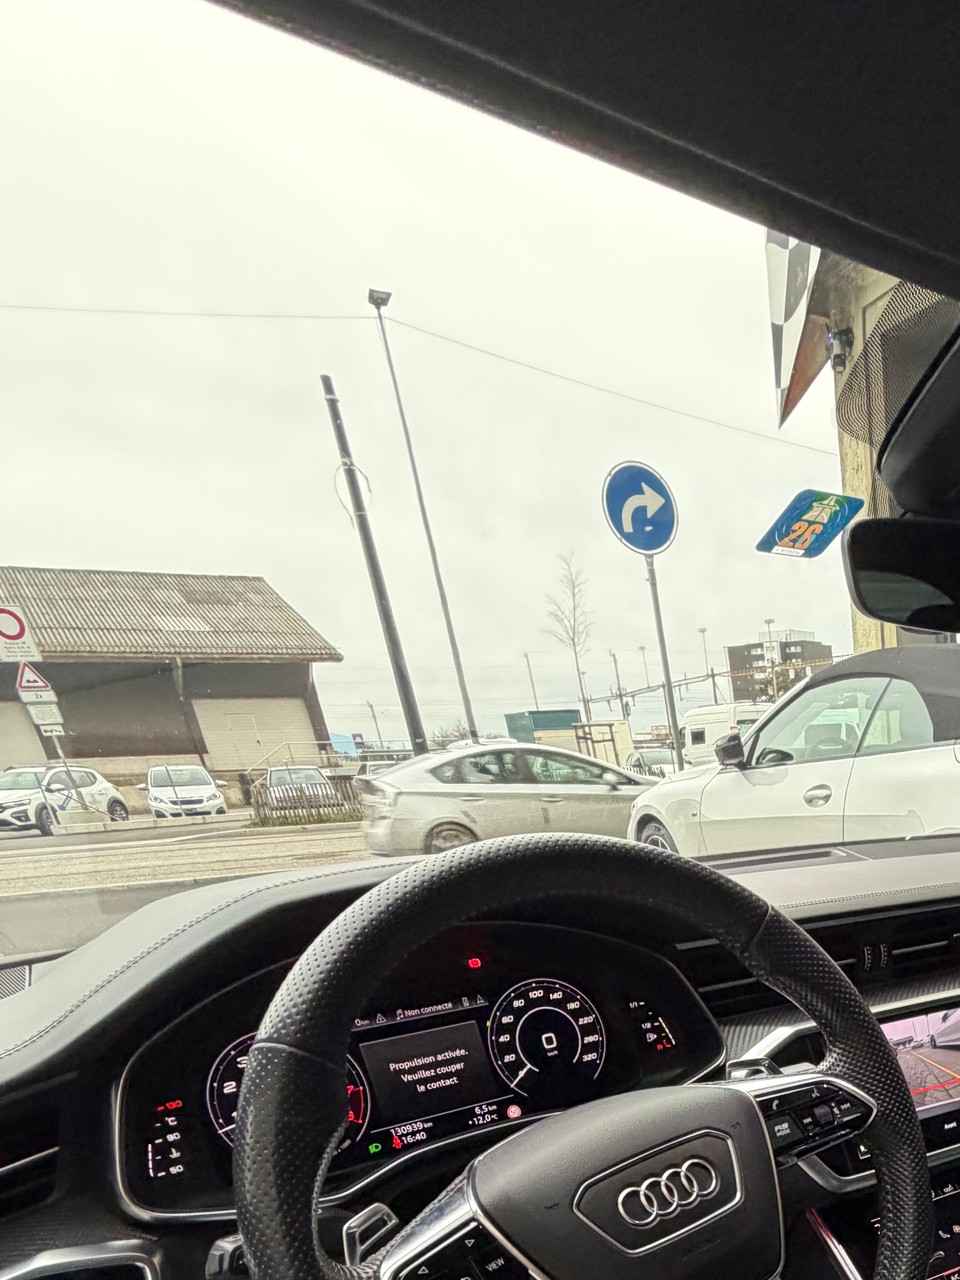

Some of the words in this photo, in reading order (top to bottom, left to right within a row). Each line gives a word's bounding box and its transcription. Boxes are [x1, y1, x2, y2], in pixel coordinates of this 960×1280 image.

[528, 989, 544, 998] 100
[549, 991, 563, 1000] 140
[404, 1008, 420, 1017] Non
[420, 1001, 453, 1015] connecté
[513, 999, 525, 1008] 80
[578, 1015, 594, 1024] 220
[498, 1033, 511, 1043] 40
[389, 1055, 436, 1072] Propulsion
[436, 1048, 469, 1062] activée.
[503, 1053, 516, 1062] 20
[582, 1052, 597, 1062] 320
[401, 1068, 436, 1083] Veuillez
[436, 1062, 465, 1076] couper
[223, 1080, 237, 1094] 2
[416, 1083, 426, 1093] le
[427, 1077, 459, 1090] contact
[390, 1121, 424, 1136] 130939
[401, 1131, 427, 1145] 16:40
[485, 1257, 505, 1273] VIEW
